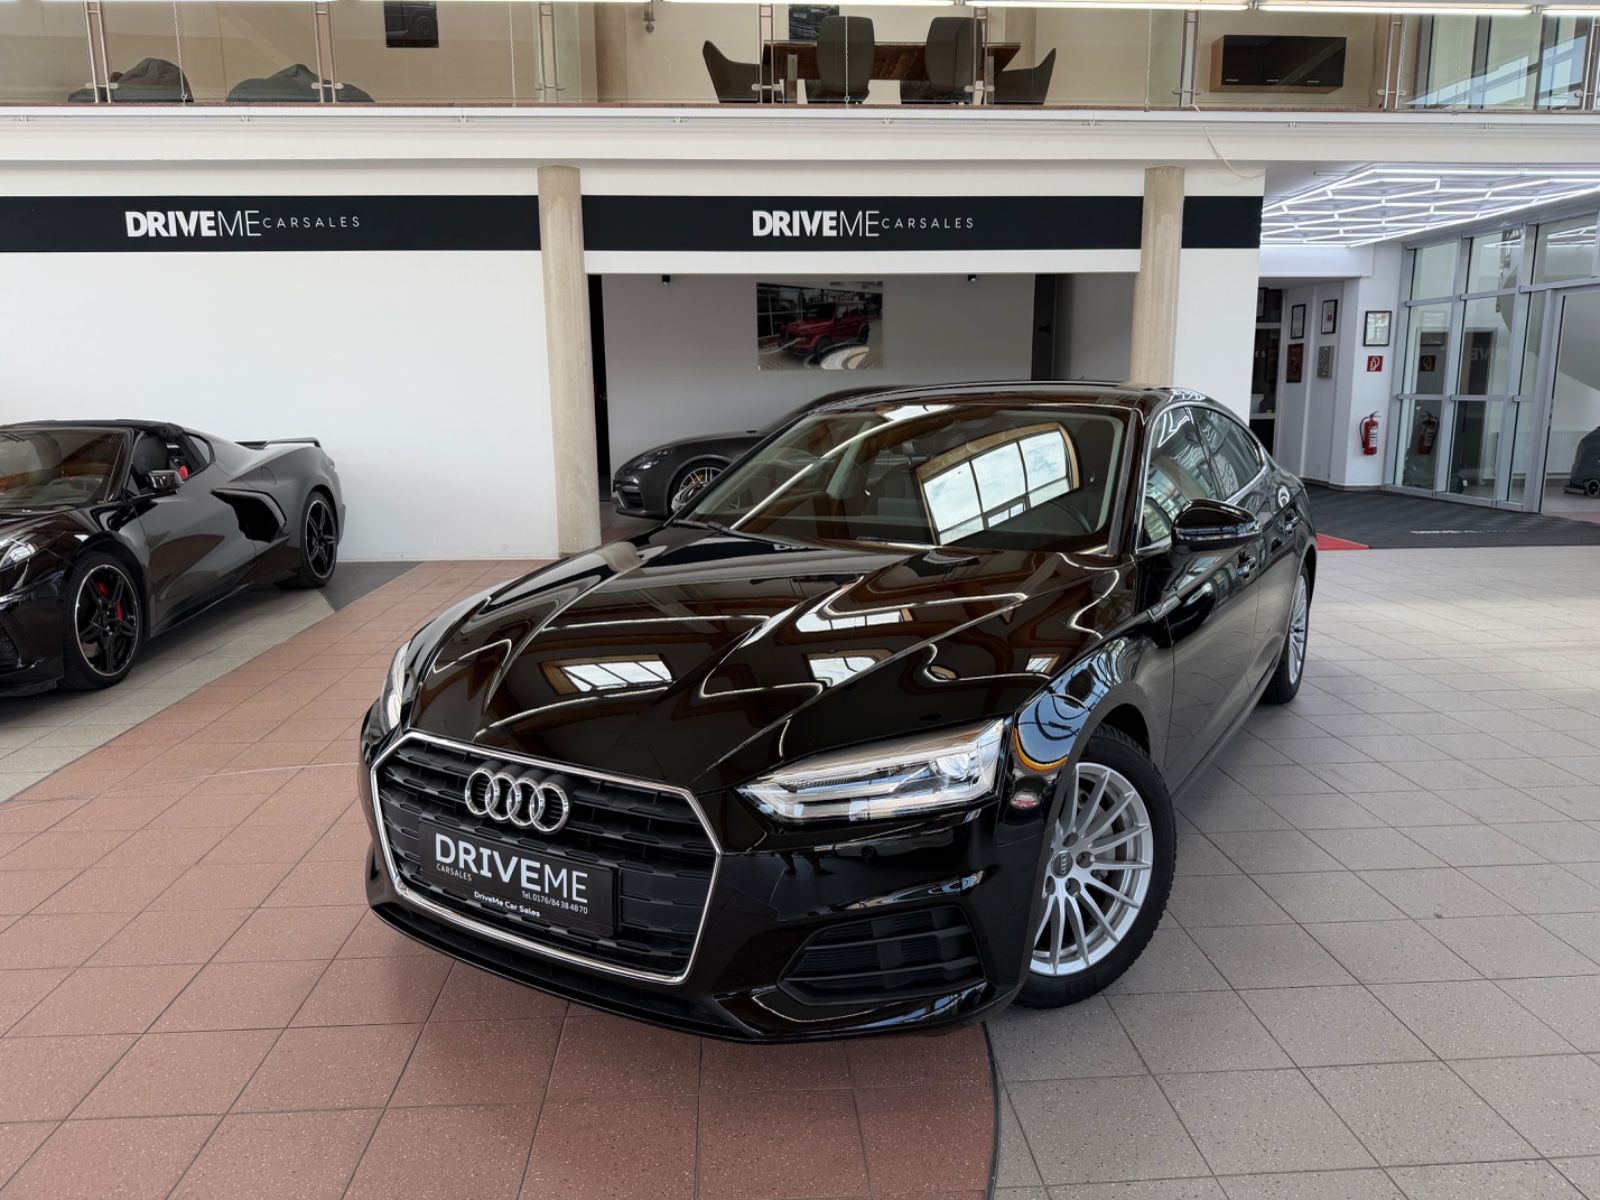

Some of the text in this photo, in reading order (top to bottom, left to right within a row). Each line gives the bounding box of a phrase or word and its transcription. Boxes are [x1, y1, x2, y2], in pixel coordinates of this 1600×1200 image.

[125, 210, 361, 238] DRIVEME CARSALES
[752, 210, 975, 238] DRIVEME CARSALES
[435, 832, 588, 904] DRIVEME
[436, 863, 473, 882] CARSALES
[474, 890, 541, 917] DriveMe Car Sales
